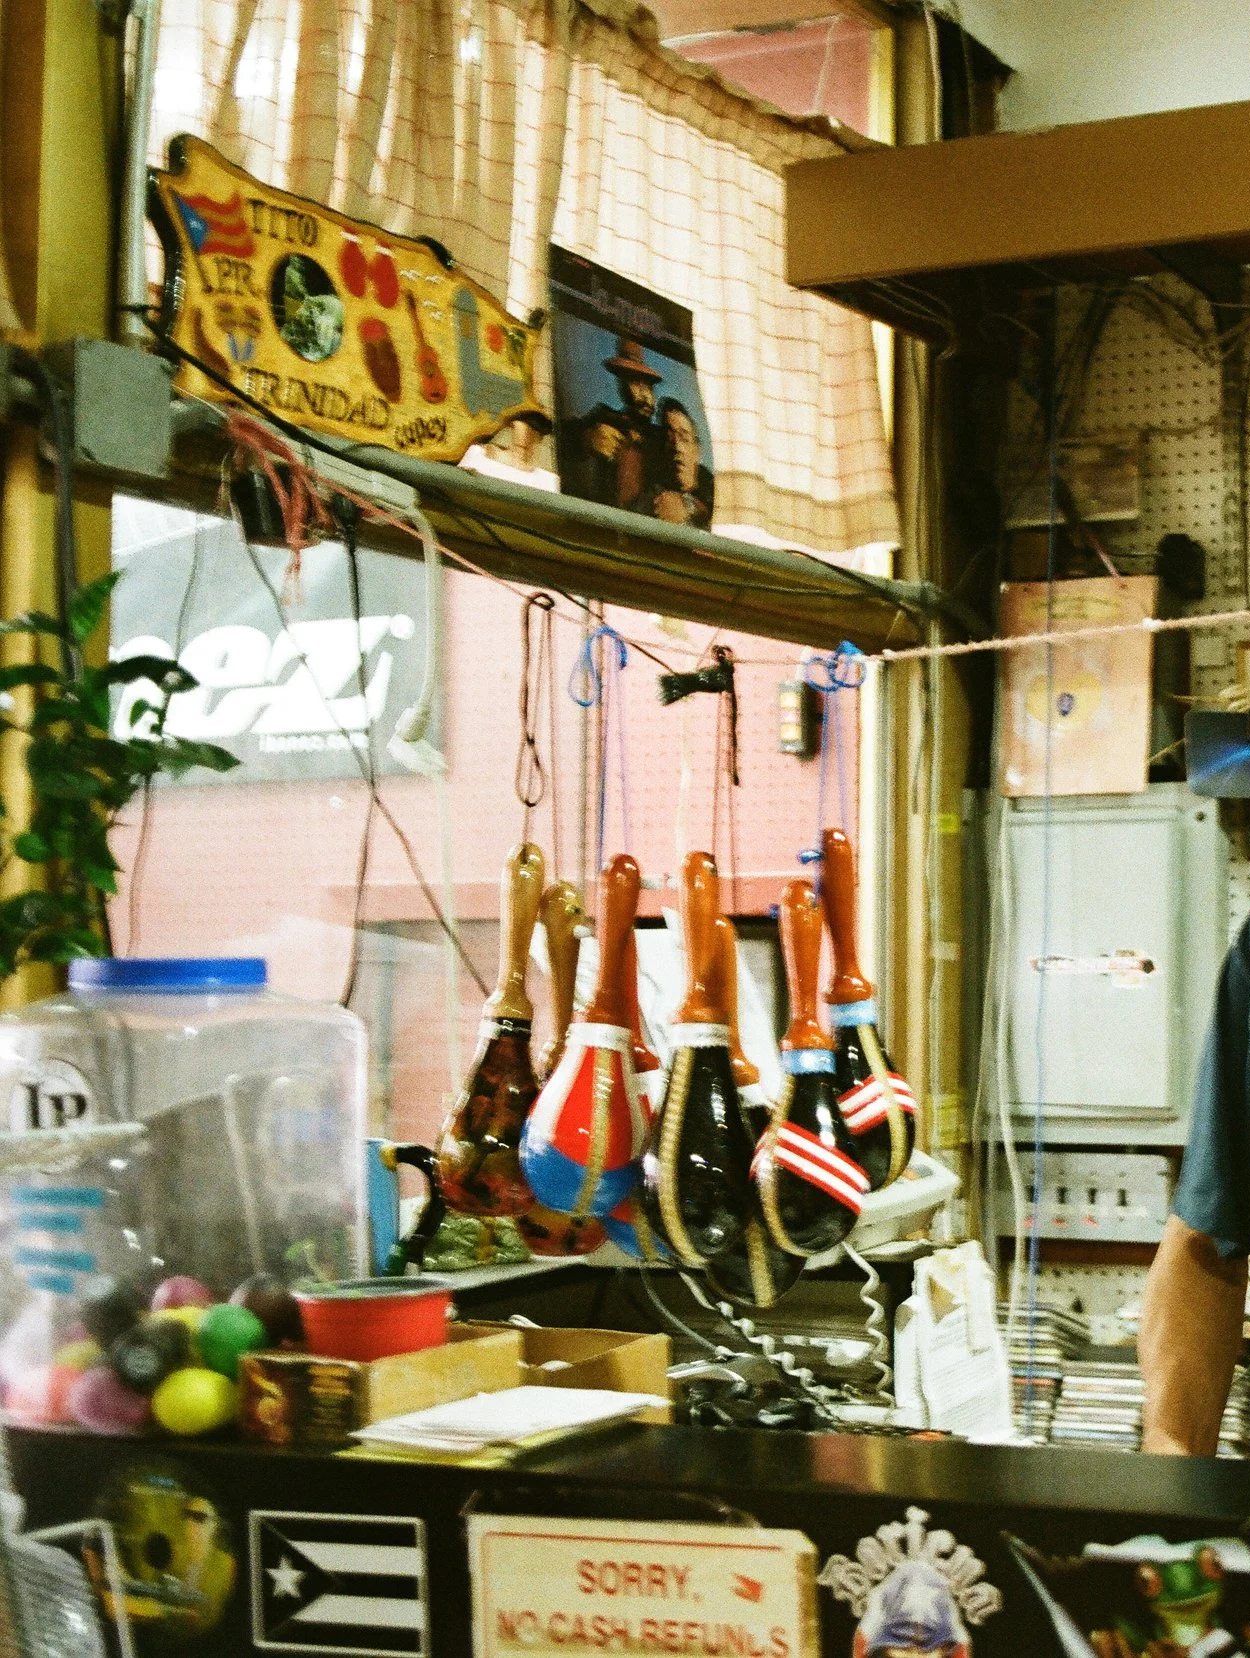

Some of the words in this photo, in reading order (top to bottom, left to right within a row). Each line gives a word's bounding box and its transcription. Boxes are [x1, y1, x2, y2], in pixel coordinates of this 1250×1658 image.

[247, 198, 318, 247] TITO
[497, 1610, 540, 1641] NO
[549, 1611, 631, 1648] CASH
